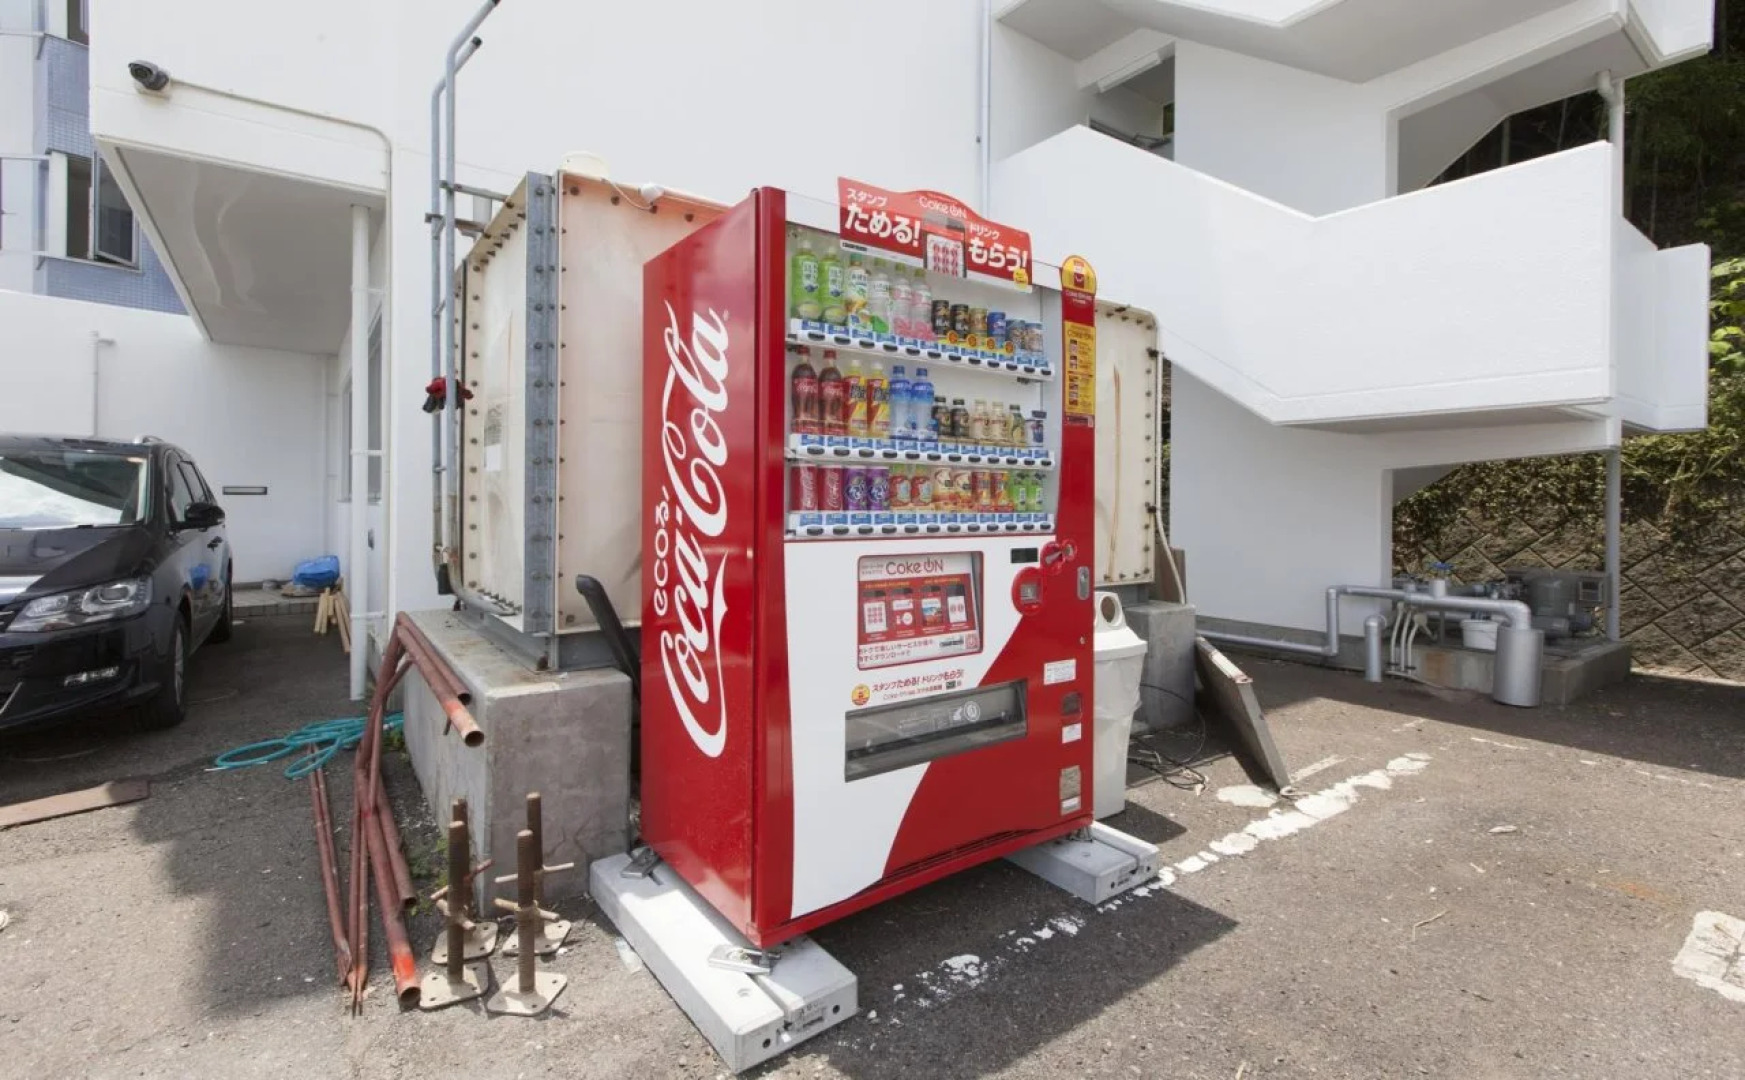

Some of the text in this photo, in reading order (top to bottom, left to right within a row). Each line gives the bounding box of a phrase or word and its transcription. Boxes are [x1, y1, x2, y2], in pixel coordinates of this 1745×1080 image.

[847, 187, 888, 208] スタンプ
[919, 195, 950, 214] Coke
[844, 202, 921, 248] ためる!
[968, 222, 1000, 240] ドリンク
[968, 235, 1028, 272] もらう!
[661, 299, 729, 758] Coca-Cola
[886, 561, 921, 575] Coke
[923, 557, 944, 572] ON
